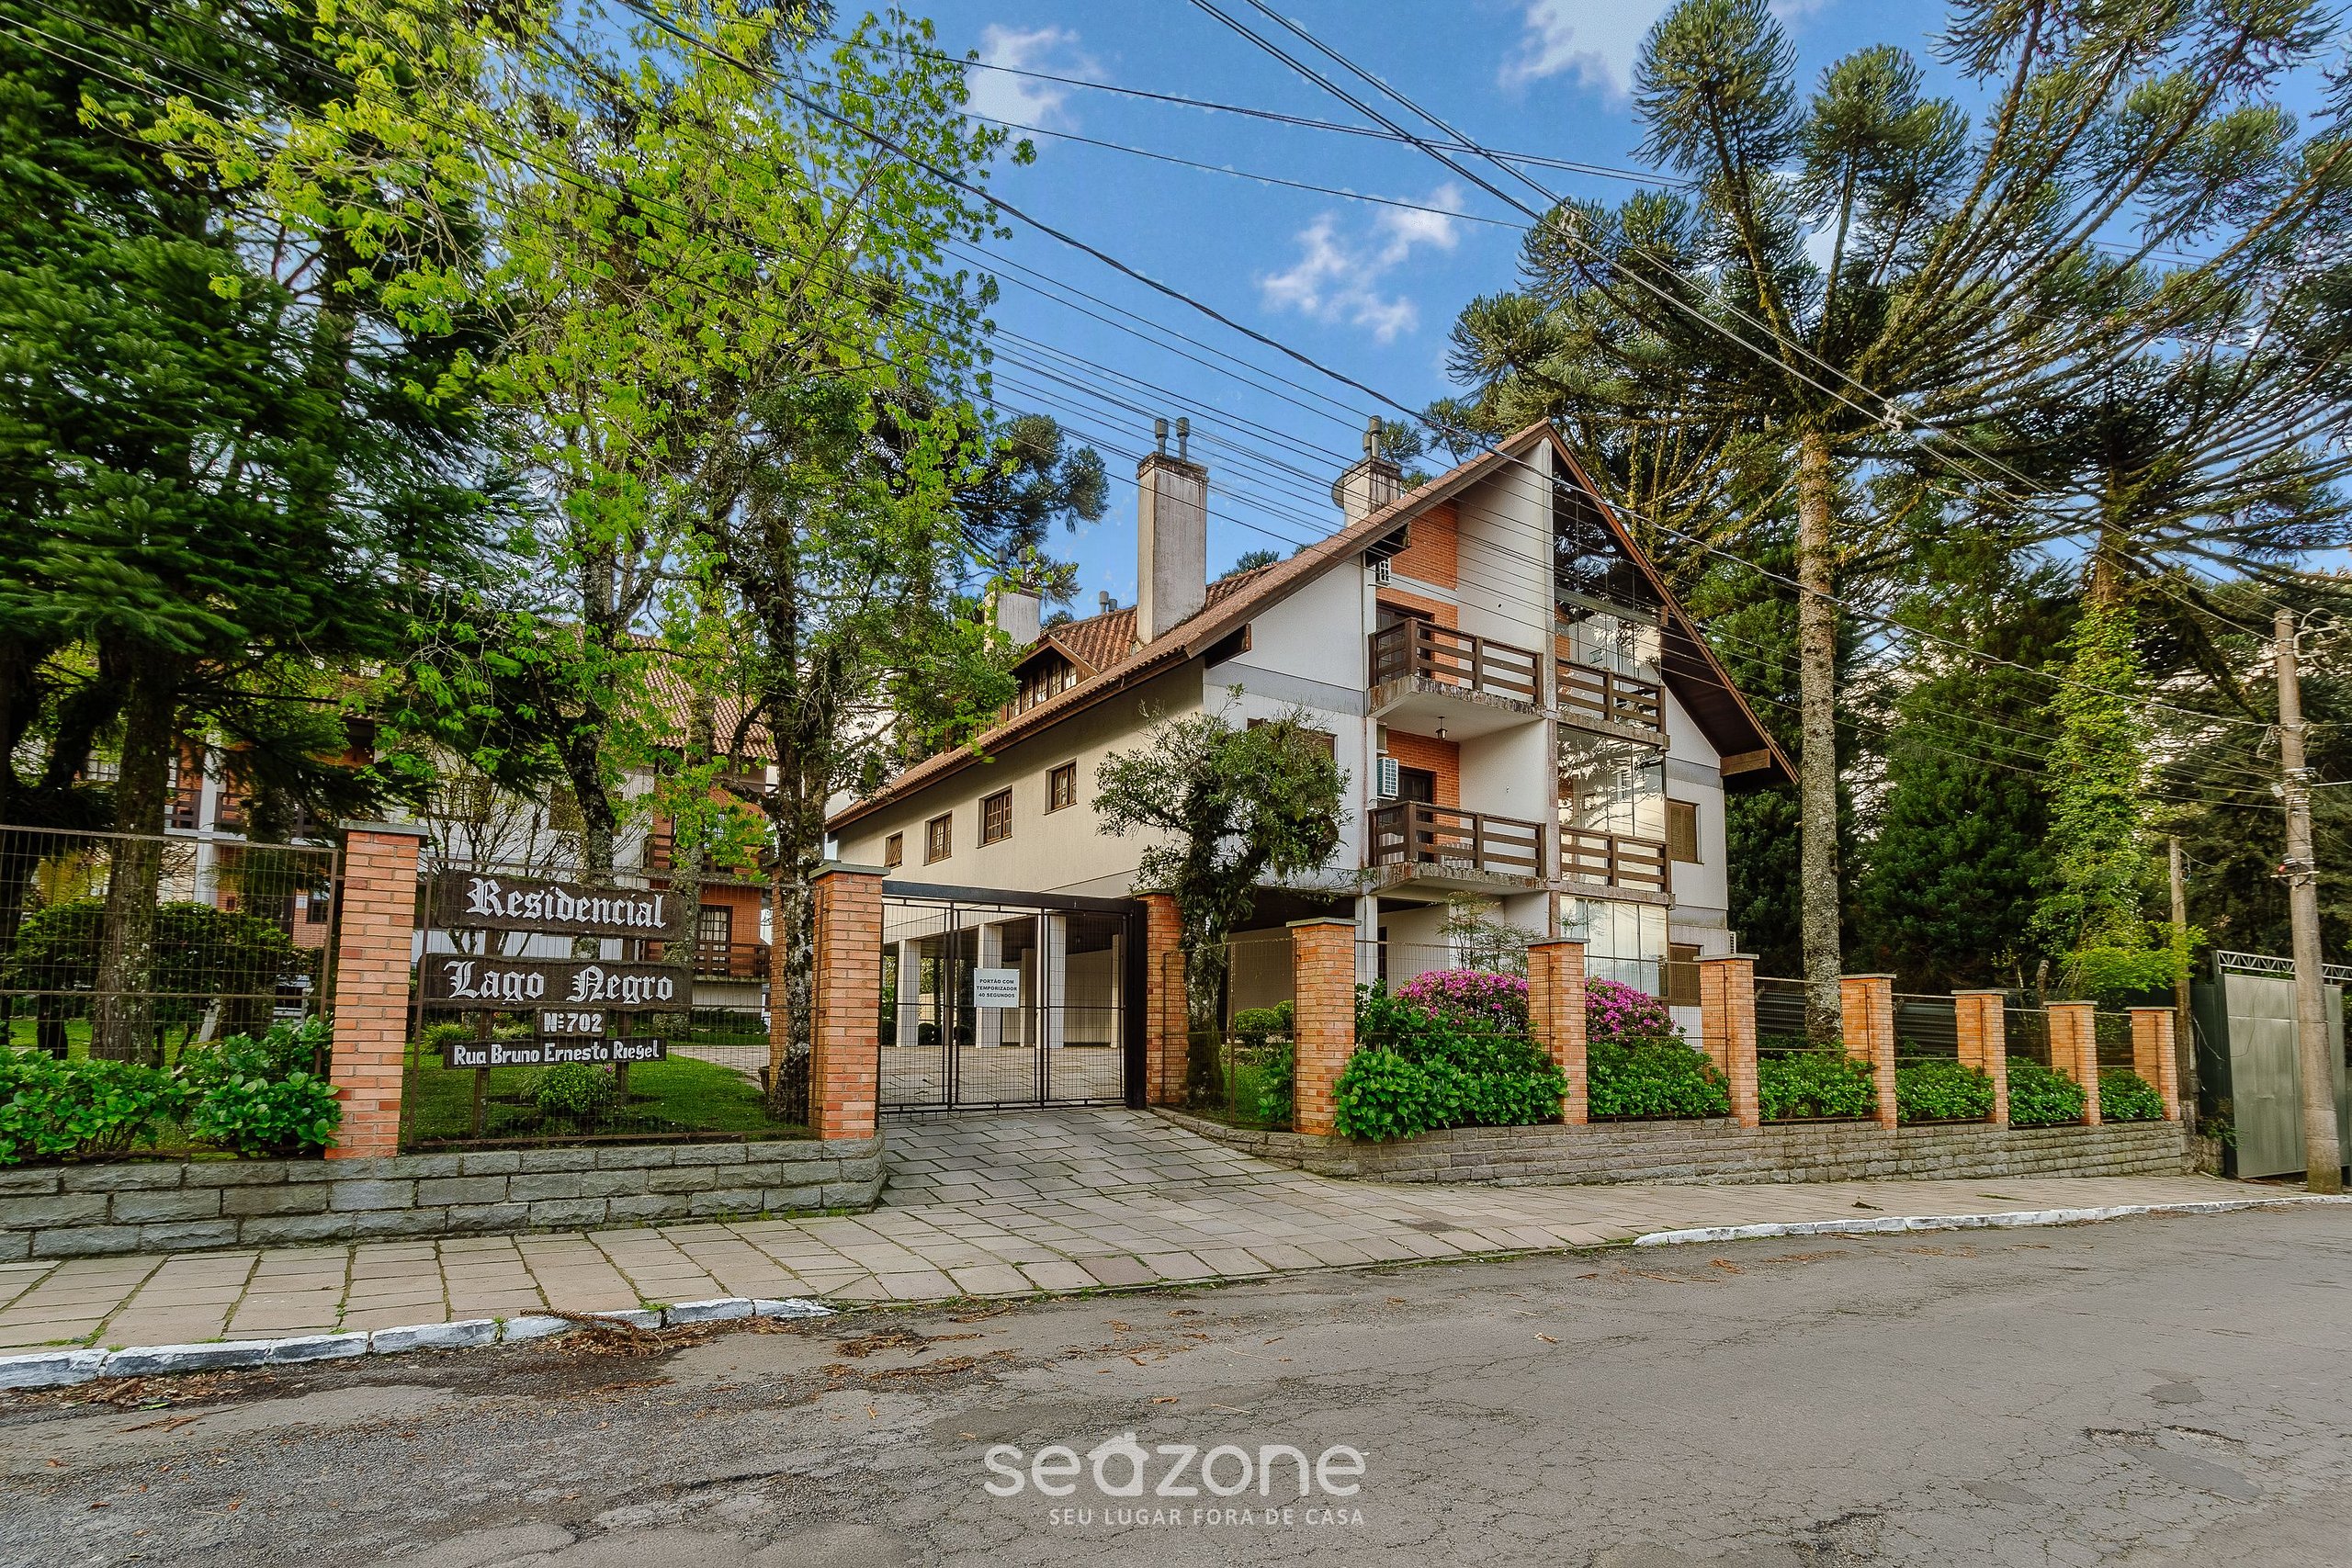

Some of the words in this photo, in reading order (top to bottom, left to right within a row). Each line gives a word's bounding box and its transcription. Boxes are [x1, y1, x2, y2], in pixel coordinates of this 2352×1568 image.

[466, 877, 667, 929] Residencial
[443, 960, 546, 1005] Lago
[566, 964, 673, 1005] Negro
[453, 1044, 487, 1066] Rua
[491, 1044, 540, 1064] Bruno
[544, 1043, 608, 1062] Ernesto
[613, 1040, 660, 1059] Riegel
